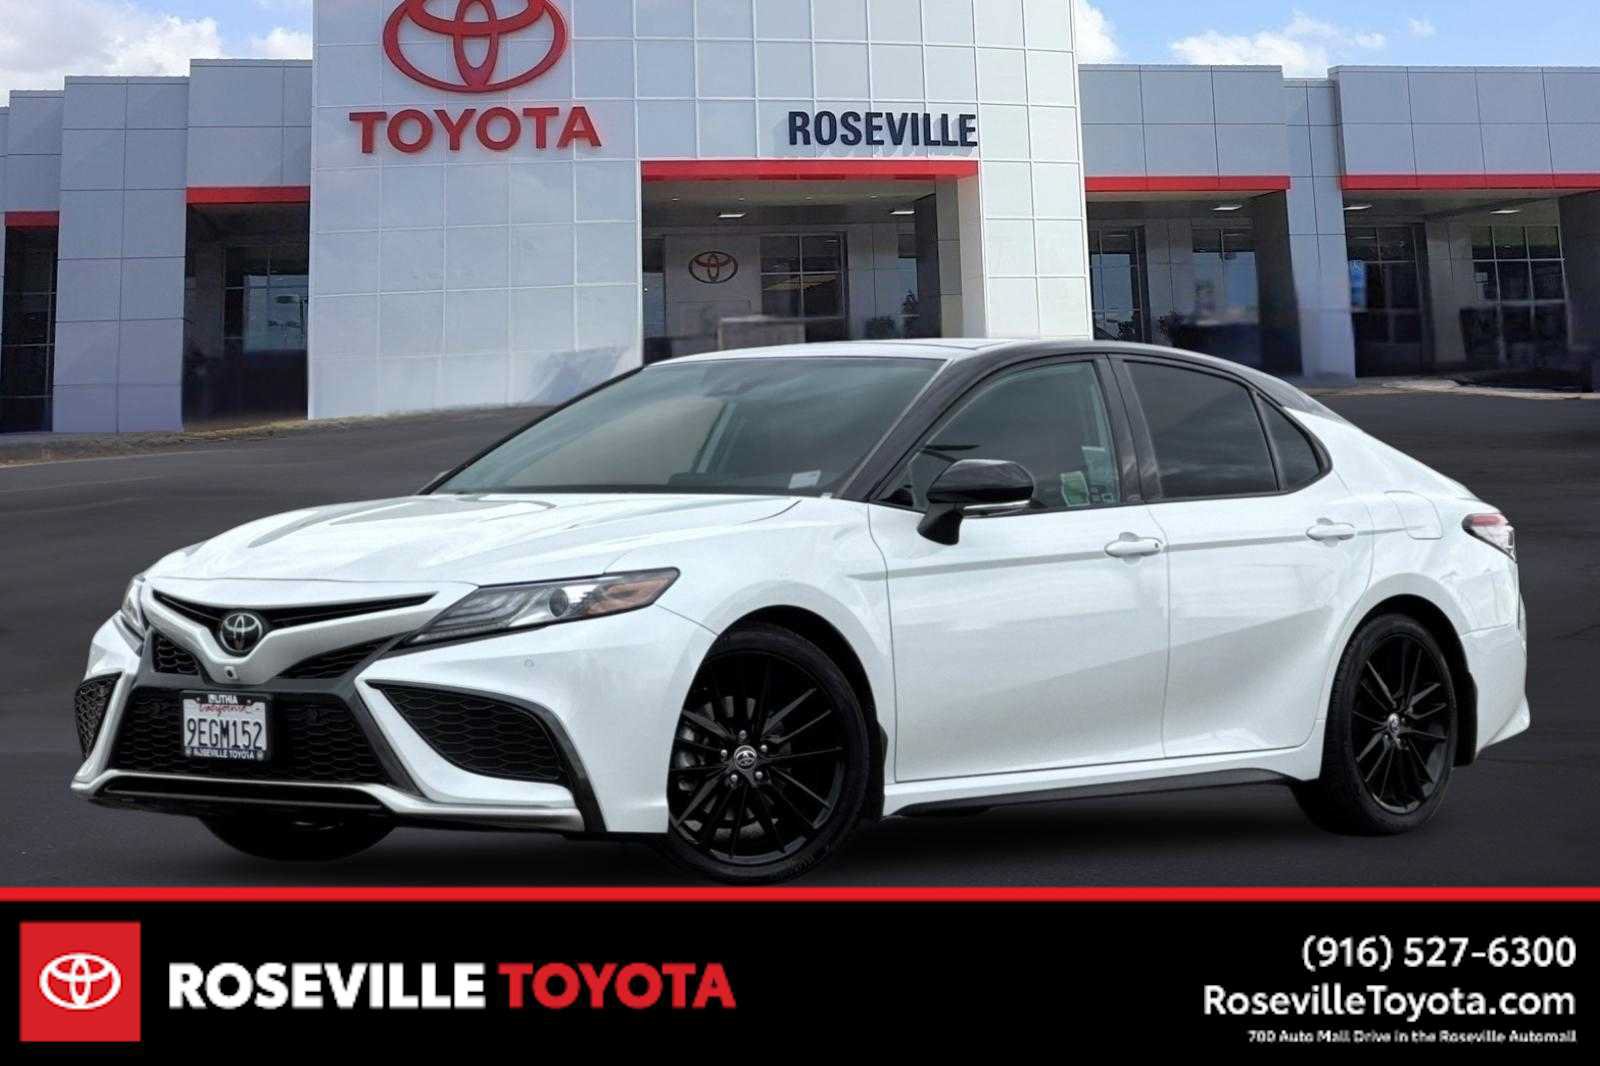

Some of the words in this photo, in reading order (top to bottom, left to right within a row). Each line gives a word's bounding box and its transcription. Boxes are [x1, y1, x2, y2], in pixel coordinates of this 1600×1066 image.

[349, 106, 602, 154] TOYOTA
[788, 110, 979, 148] ROSEVILLE
[187, 718, 263, 750] 9EGM152
